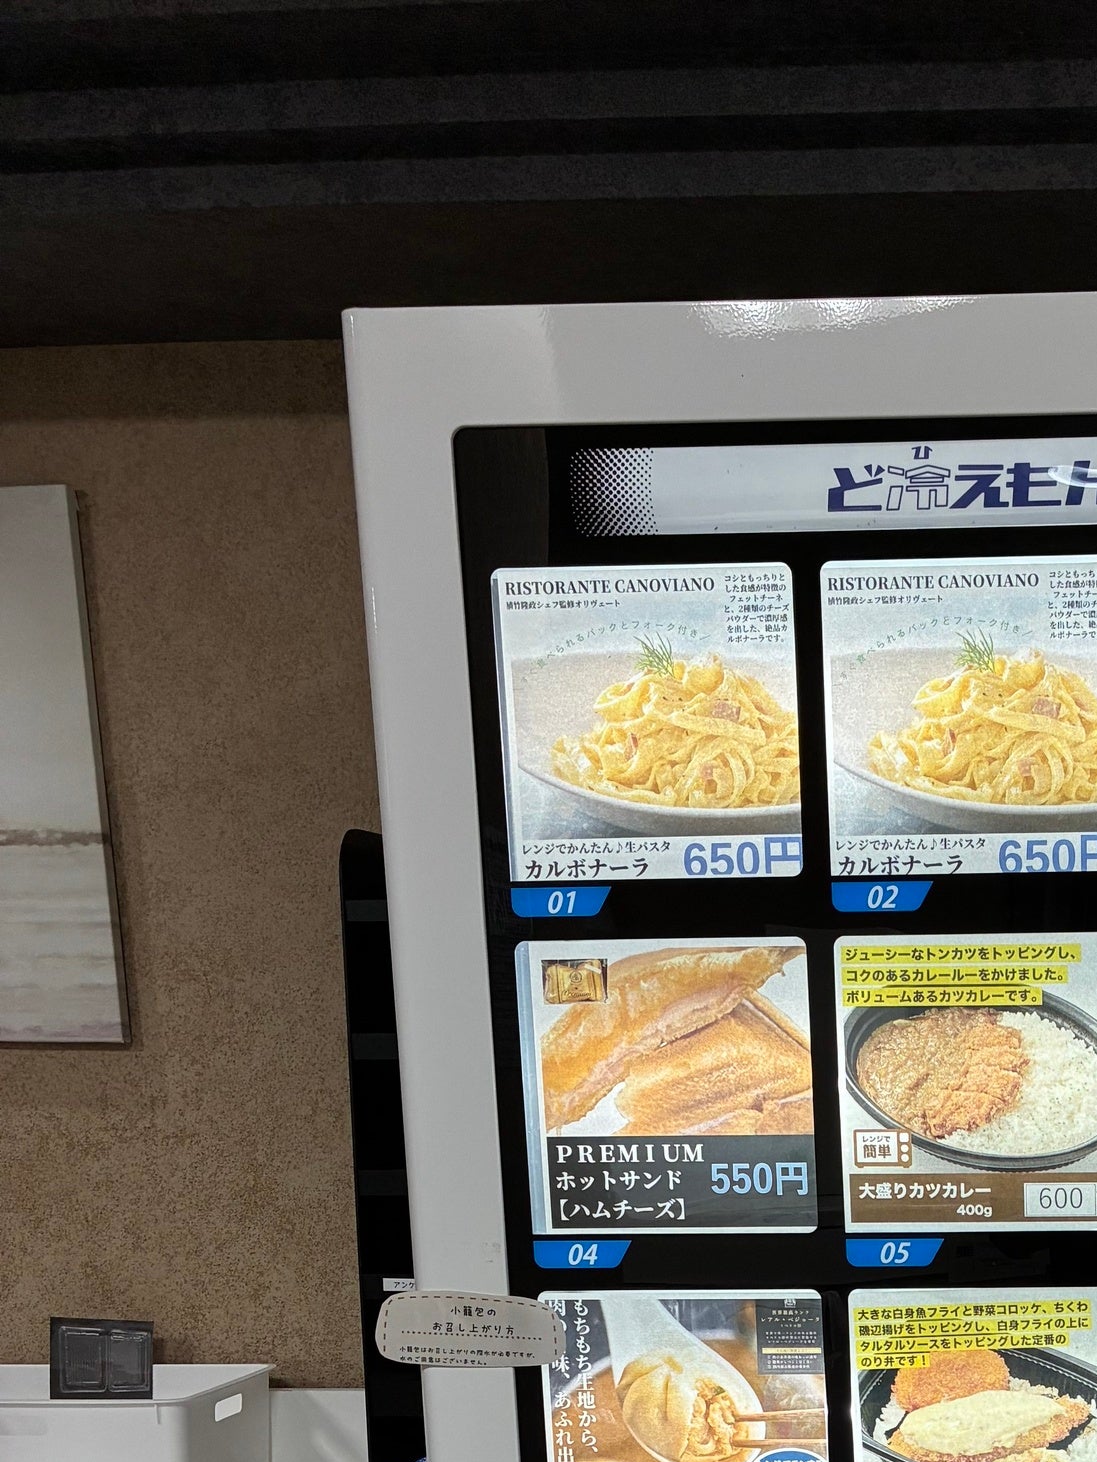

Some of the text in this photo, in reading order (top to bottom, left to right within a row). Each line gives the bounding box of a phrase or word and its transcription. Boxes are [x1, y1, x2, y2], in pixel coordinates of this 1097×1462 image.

[505, 577, 715, 596] RISTORANTE CANOVIANO
[827, 573, 1039, 591] RISTORANTE CANOVIANO
[683, 837, 801, 876] 650円
[838, 855, 964, 875] カルボナーラ
[525, 857, 649, 879] カルボナーラ
[547, 890, 577, 915] 01
[867, 885, 899, 909] 02
[845, 947, 1077, 962] ジューシーなトンカツをトッピングし、
[846, 968, 1064, 982] コクのあるカレールーをかけました。
[846, 989, 1039, 1004] ボリュームあるカツカレーです。
[861, 1135, 891, 1143] レンジで
[556, 1144, 705, 1164] PREMIUM
[862, 1144, 892, 1160] 簡単
[555, 1169, 682, 1192] ホットサンド
[711, 1162, 808, 1196] 550円
[858, 1182, 992, 1200] 大盛りカツカレー
[1039, 1187, 1083, 1210] 600
[559, 1198, 686, 1221] 【ハムチーズ】
[956, 1204, 993, 1218] 400g
[568, 1243, 598, 1266] 04
[880, 1241, 911, 1264] 05
[451, 1306, 496, 1317] 小籠包の
[432, 1322, 514, 1335] お召し上がり方
[860, 1335, 1066, 1352] タルタルソースをトッピングした定番の
[574, 1300, 599, 1453] もちもち生地から、
